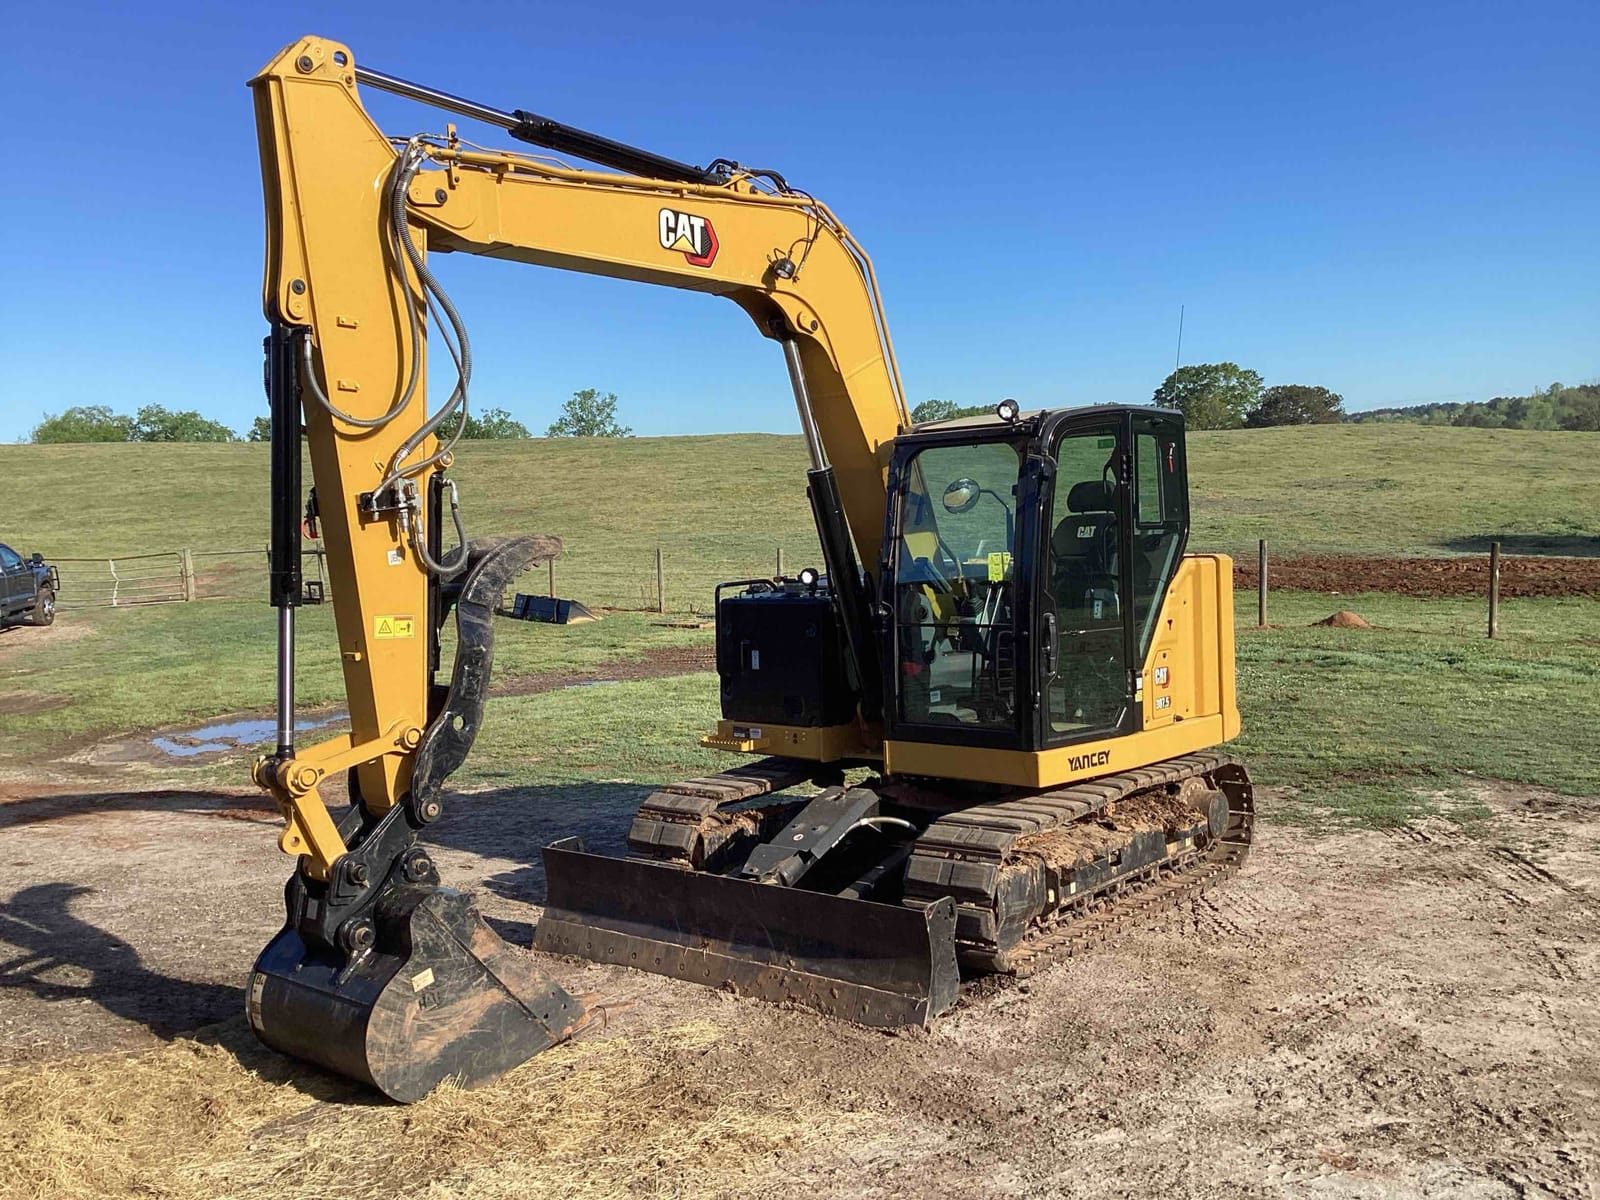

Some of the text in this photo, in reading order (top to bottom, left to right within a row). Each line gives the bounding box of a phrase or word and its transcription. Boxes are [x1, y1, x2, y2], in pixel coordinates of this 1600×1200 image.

[660, 209, 704, 255] CAT
[1077, 526, 1096, 538] CAT
[1155, 667, 1168, 685] CAT
[1068, 750, 1110, 772] YANCEY
